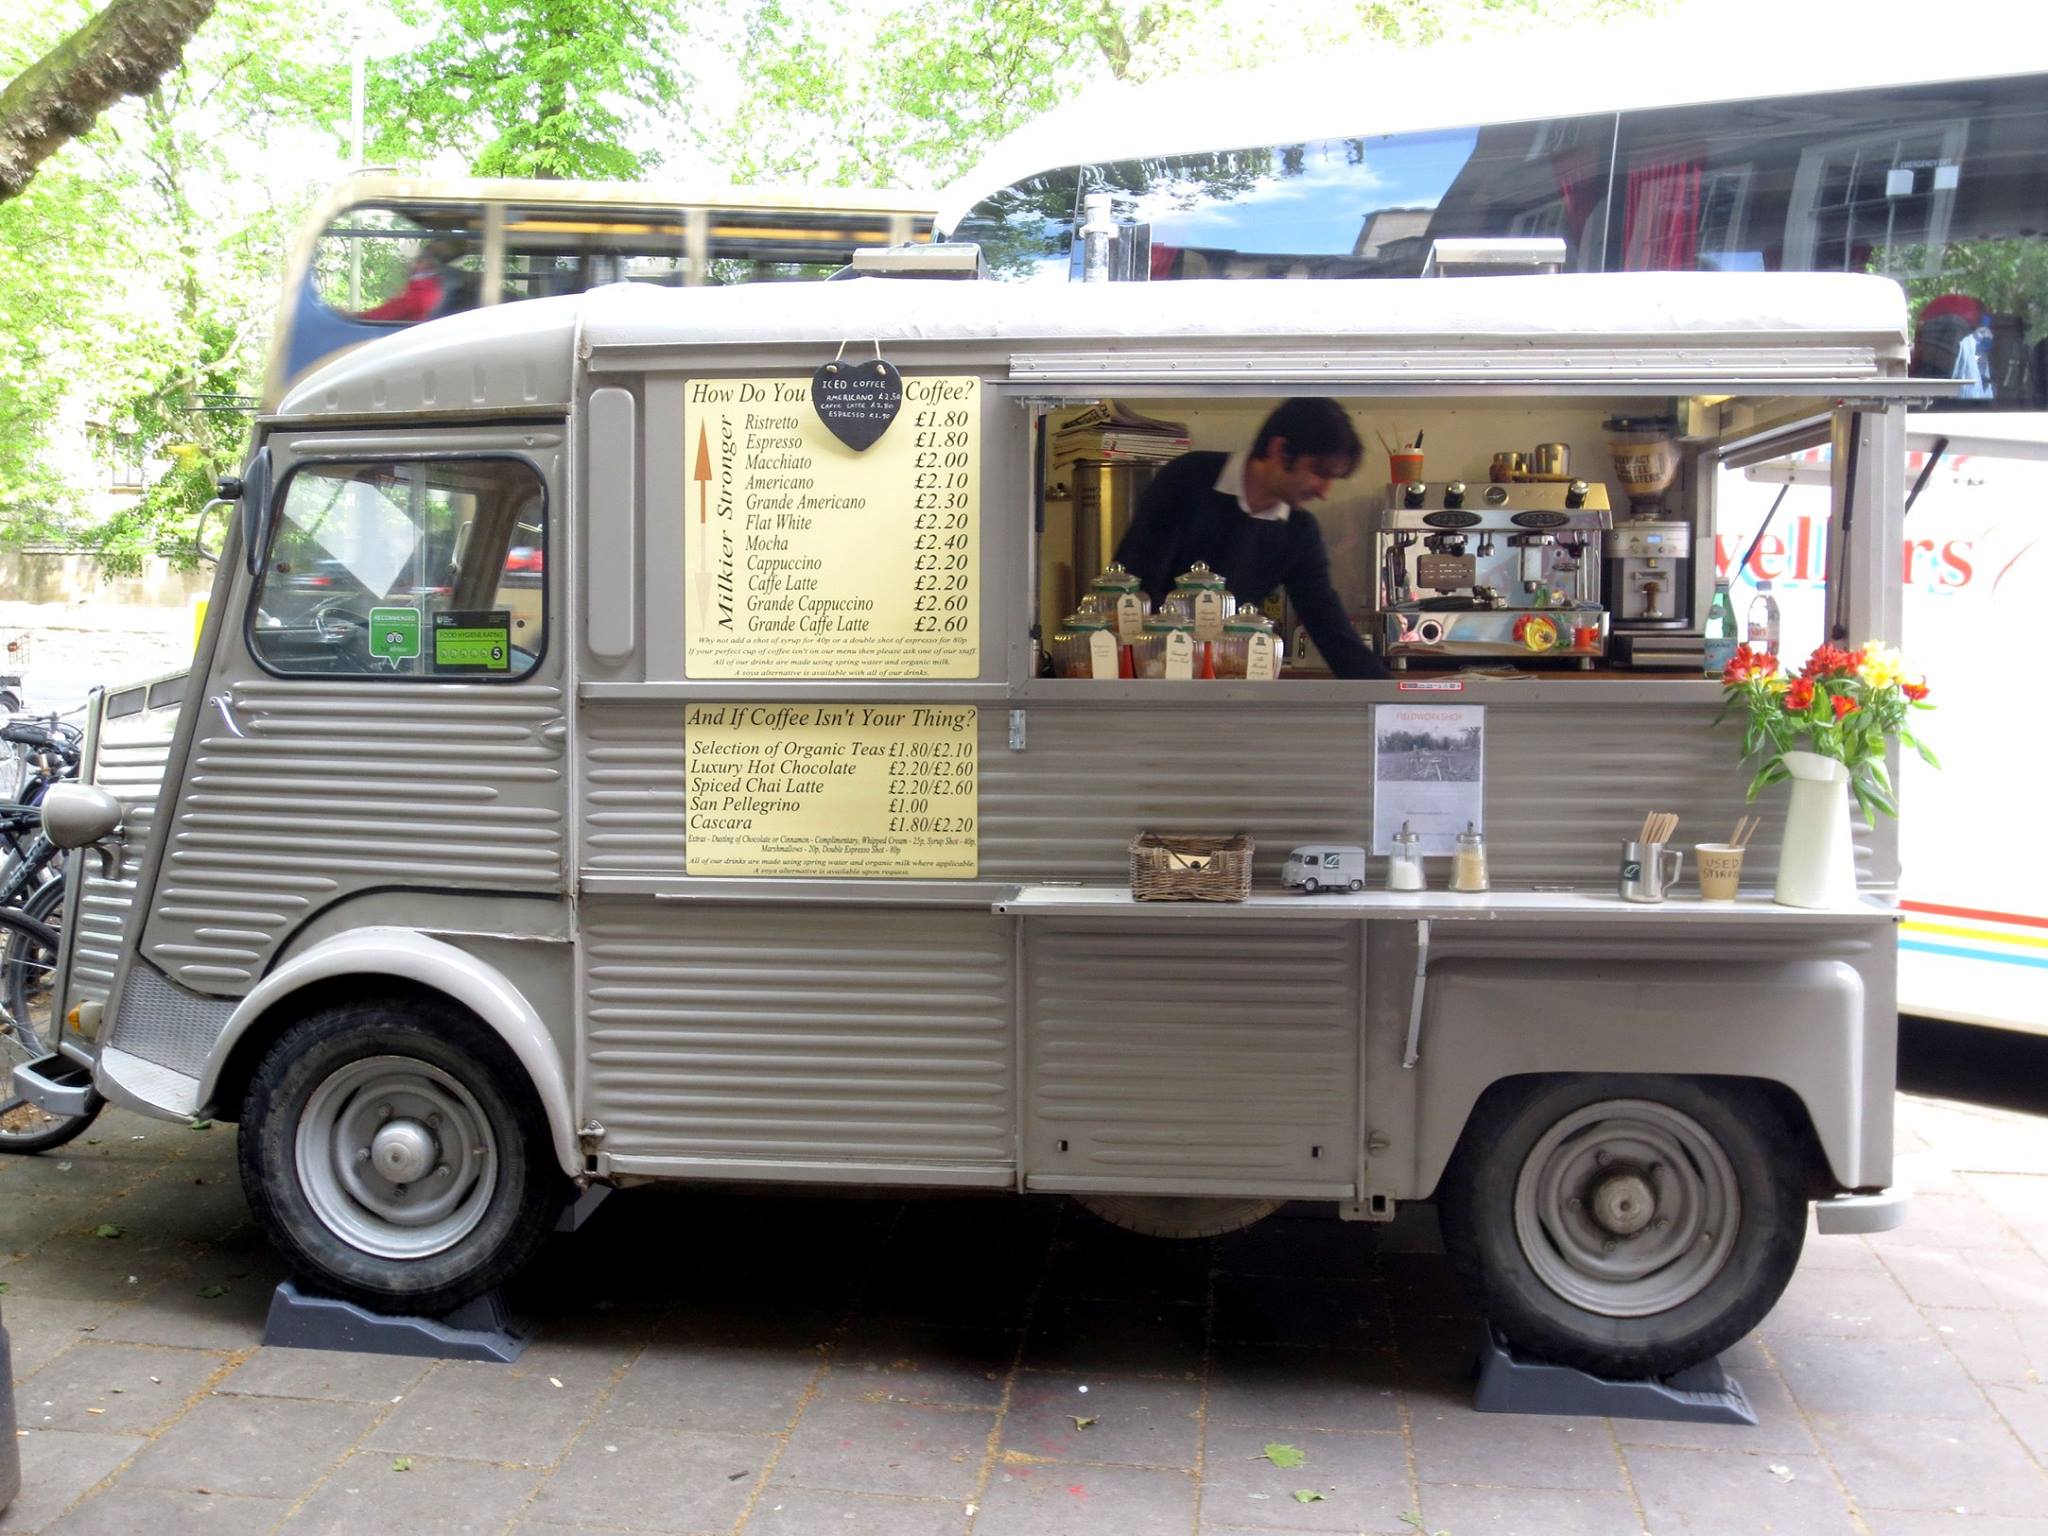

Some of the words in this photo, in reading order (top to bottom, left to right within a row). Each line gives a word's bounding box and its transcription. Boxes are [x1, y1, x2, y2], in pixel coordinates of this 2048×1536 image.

[691, 383, 736, 404] How
[739, 383, 766, 403] Do
[773, 382, 806, 403] You
[905, 380, 974, 405] Coffee?
[822, 380, 847, 389] ICED
[853, 380, 886, 389] COFFEE
[744, 414, 799, 430] Ristretto
[914, 411, 969, 428] £1.80
[746, 434, 803, 452] Espresso
[913, 431, 969, 448] £1.80
[717, 414, 737, 520] Stronger
[745, 454, 812, 470] Macchiato
[913, 452, 969, 469] £2.00
[745, 475, 814, 491] Americano
[913, 472, 969, 489] £2.10
[746, 495, 796, 511] Grande
[796, 494, 866, 510] Americano
[913, 493, 969, 510] £2.30
[745, 514, 775, 530] Flat
[776, 514, 812, 530] White
[913, 513, 969, 530] £2.20
[745, 534, 789, 551] Mocha
[913, 533, 969, 550] £2.40
[747, 554, 822, 574] Cappuccino
[913, 554, 969, 571] £2.20
[718, 529, 734, 631] Milkier
[748, 574, 782, 595] Caffe
[784, 574, 818, 591] Latte
[913, 574, 969, 591] £2.20
[747, 595, 794, 611] Grande
[798, 595, 874, 615] Cappuccino
[913, 595, 969, 612] £2.60
[748, 615, 796, 632] Grande
[799, 615, 834, 635] Caffe
[836, 615, 870, 632] Latte
[913, 615, 969, 632] £2.60
[493, 648, 501, 658] 5
[688, 708, 724, 726] And
[729, 708, 748, 730] If
[750, 708, 810, 731] Coffee
[813, 708, 855, 727] Isn't
[861, 709, 906, 727] Your
[911, 709, 977, 732] Thing?
[692, 741, 760, 755] Selection
[764, 741, 782, 759] of
[784, 741, 846, 759] Organic
[850, 742, 886, 756] Teas
[888, 742, 973, 758] £1.80/£2.10
[690, 760, 743, 778] Luxury
[747, 760, 776, 775] Hot
[780, 760, 857, 775] Chocolate
[888, 761, 973, 777] £2.20/£2.60
[691, 778, 741, 796] Spiced
[745, 778, 781, 794] Chai
[786, 778, 824, 794] Latte
[888, 779, 973, 795] £2.20/£2.60
[690, 796, 718, 812] San
[722, 796, 800, 815] Pellegrino
[888, 798, 928, 814] £1.00
[690, 815, 752, 830] Cascara
[888, 817, 973, 833] £1.80/£2.20
